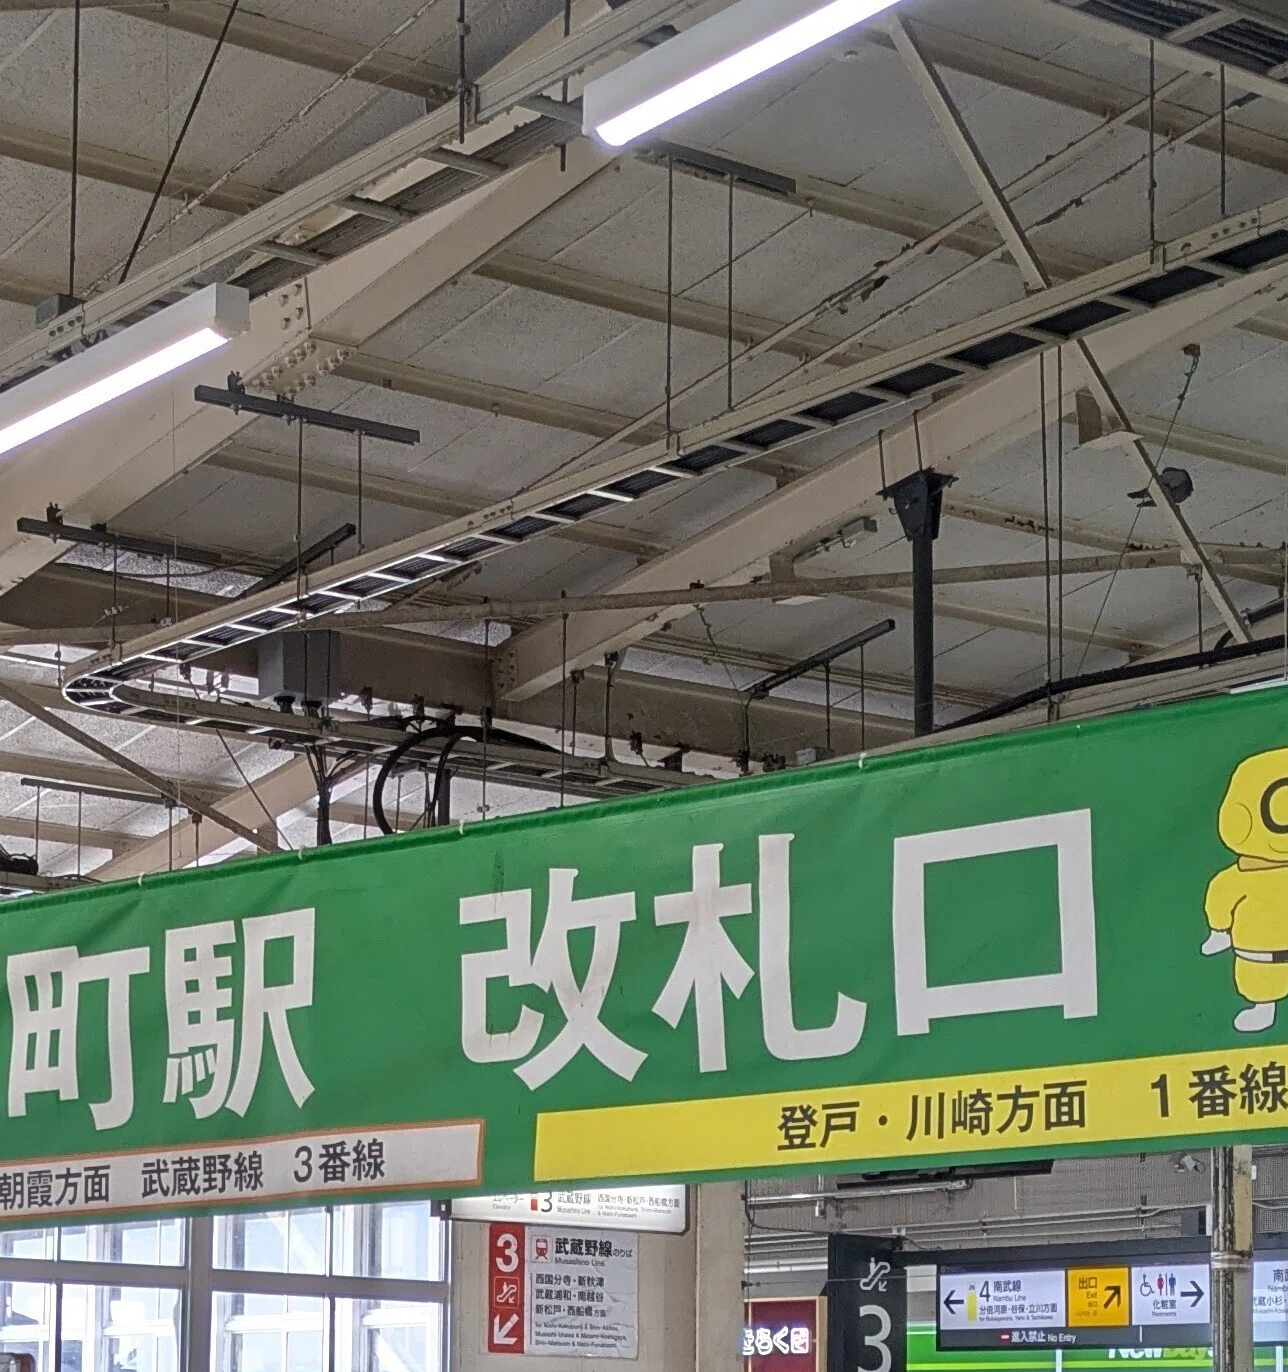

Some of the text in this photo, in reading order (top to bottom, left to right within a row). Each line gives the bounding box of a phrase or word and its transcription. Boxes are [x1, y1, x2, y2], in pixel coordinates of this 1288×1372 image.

[459, 808, 1099, 1091] 改札口
[777, 1081, 1088, 1152] 登戸・川崎方面
[140, 1149, 265, 1198] 武蔵野線
[293, 1138, 387, 1184] 3番線
[496, 1233, 520, 1273] 3
[979, 1280, 991, 1302] 4
[993, 1279, 1022, 1292] 南武線
[1078, 1277, 1098, 1290] 出口
[1011, 1331, 1046, 1343] 進入禁止
[1047, 1333, 1058, 1342] No
